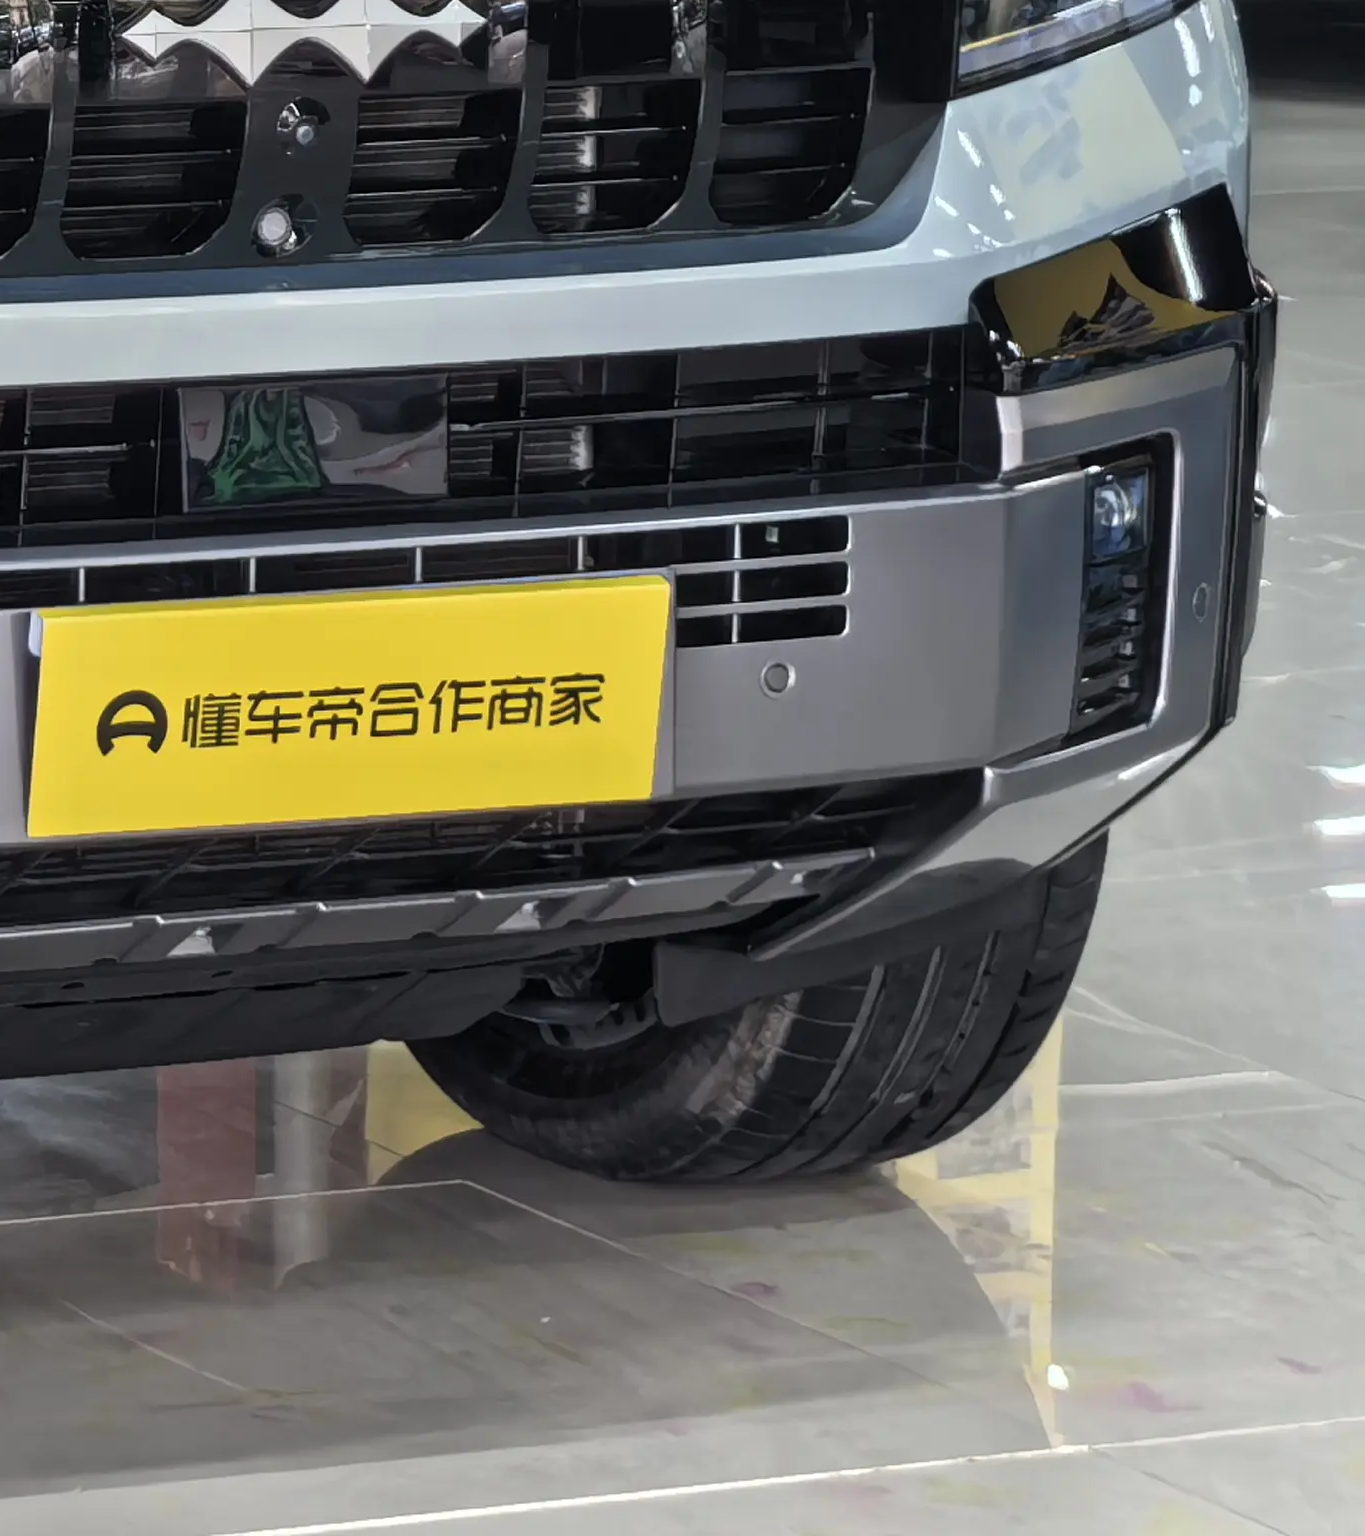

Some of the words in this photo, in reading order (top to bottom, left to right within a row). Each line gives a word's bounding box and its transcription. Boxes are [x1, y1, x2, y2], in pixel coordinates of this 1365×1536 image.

[181, 672, 606, 749] 懂车帝合作商家
